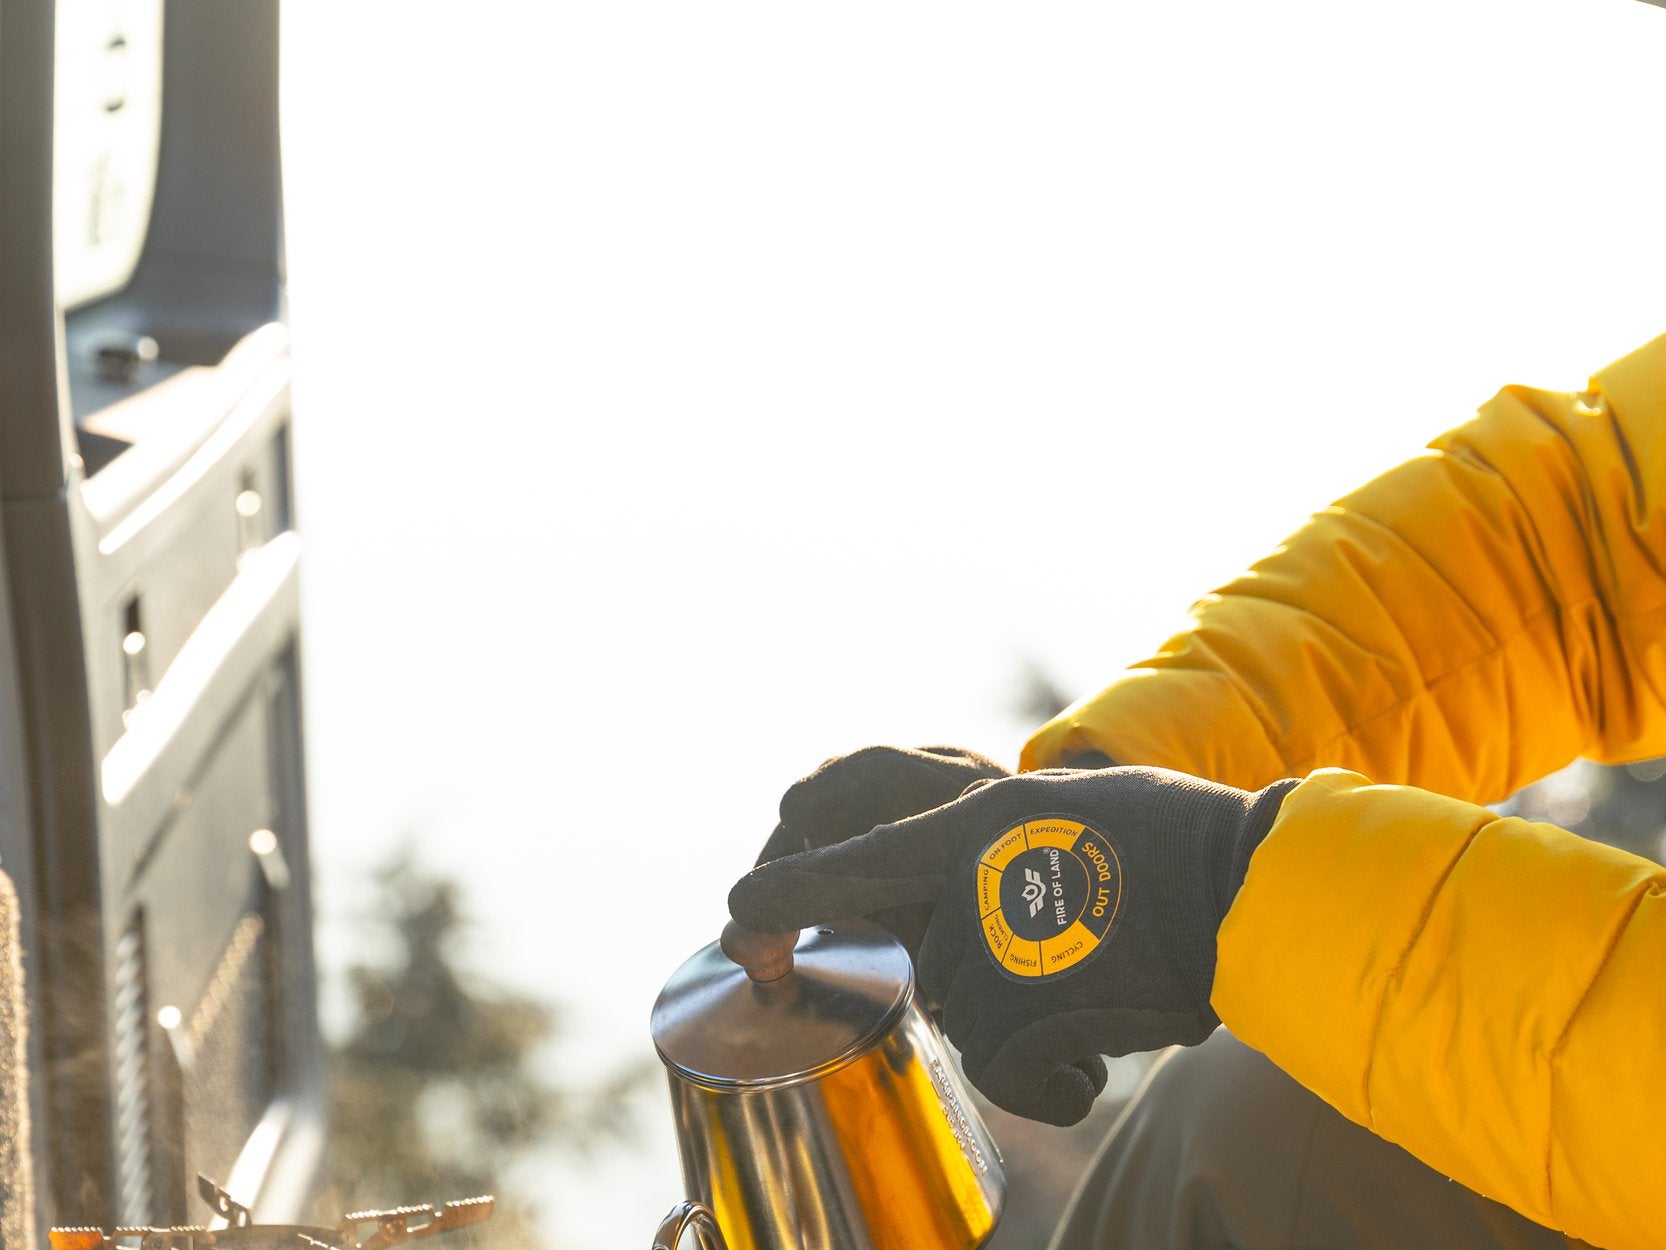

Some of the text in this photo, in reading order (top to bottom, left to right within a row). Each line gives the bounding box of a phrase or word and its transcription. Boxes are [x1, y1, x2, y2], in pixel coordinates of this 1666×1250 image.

[1030, 826, 1078, 837] EXPEDITION
[989, 833, 1022, 860] ON FOOT
[1049, 849, 1068, 926] FIRE OF LAND
[1081, 841, 1111, 918] OUT DOORS
[988, 923, 1003, 950] ROCK
[1009, 953, 1037, 967] FISHING
[1050, 941, 1084, 963] CYCLING
